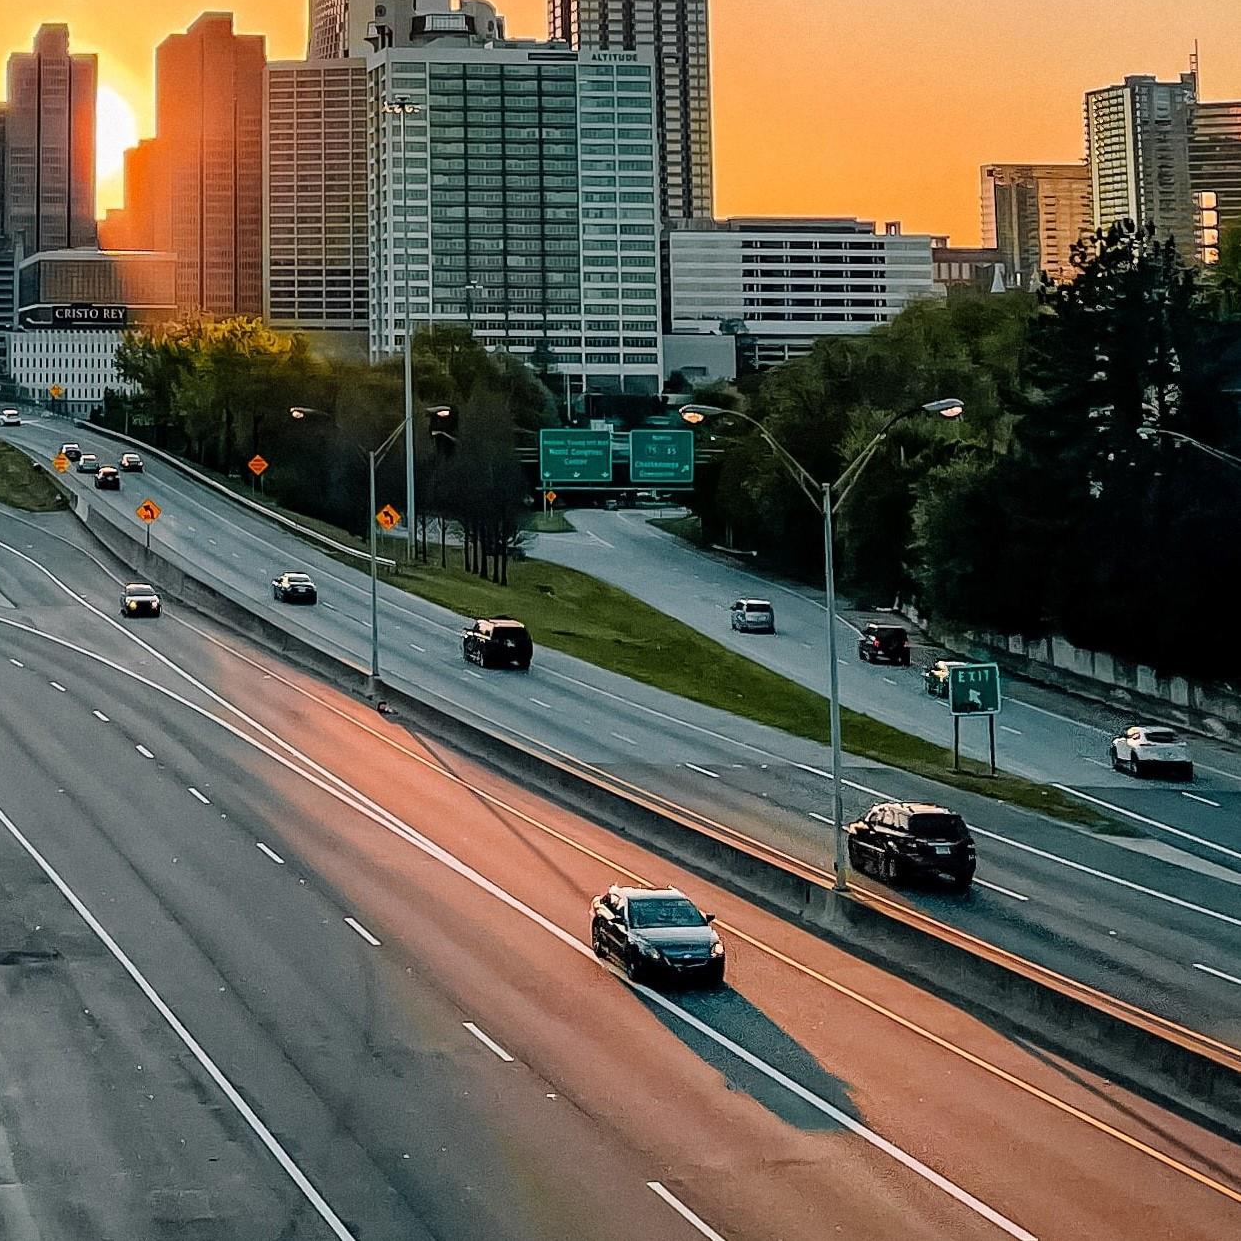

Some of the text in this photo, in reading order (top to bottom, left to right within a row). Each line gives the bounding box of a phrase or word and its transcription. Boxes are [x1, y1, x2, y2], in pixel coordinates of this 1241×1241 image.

[592, 53, 638, 62] ALTITUDE
[55, 308, 125, 318] CRISTO REY
[958, 670, 988, 682] EXIT
